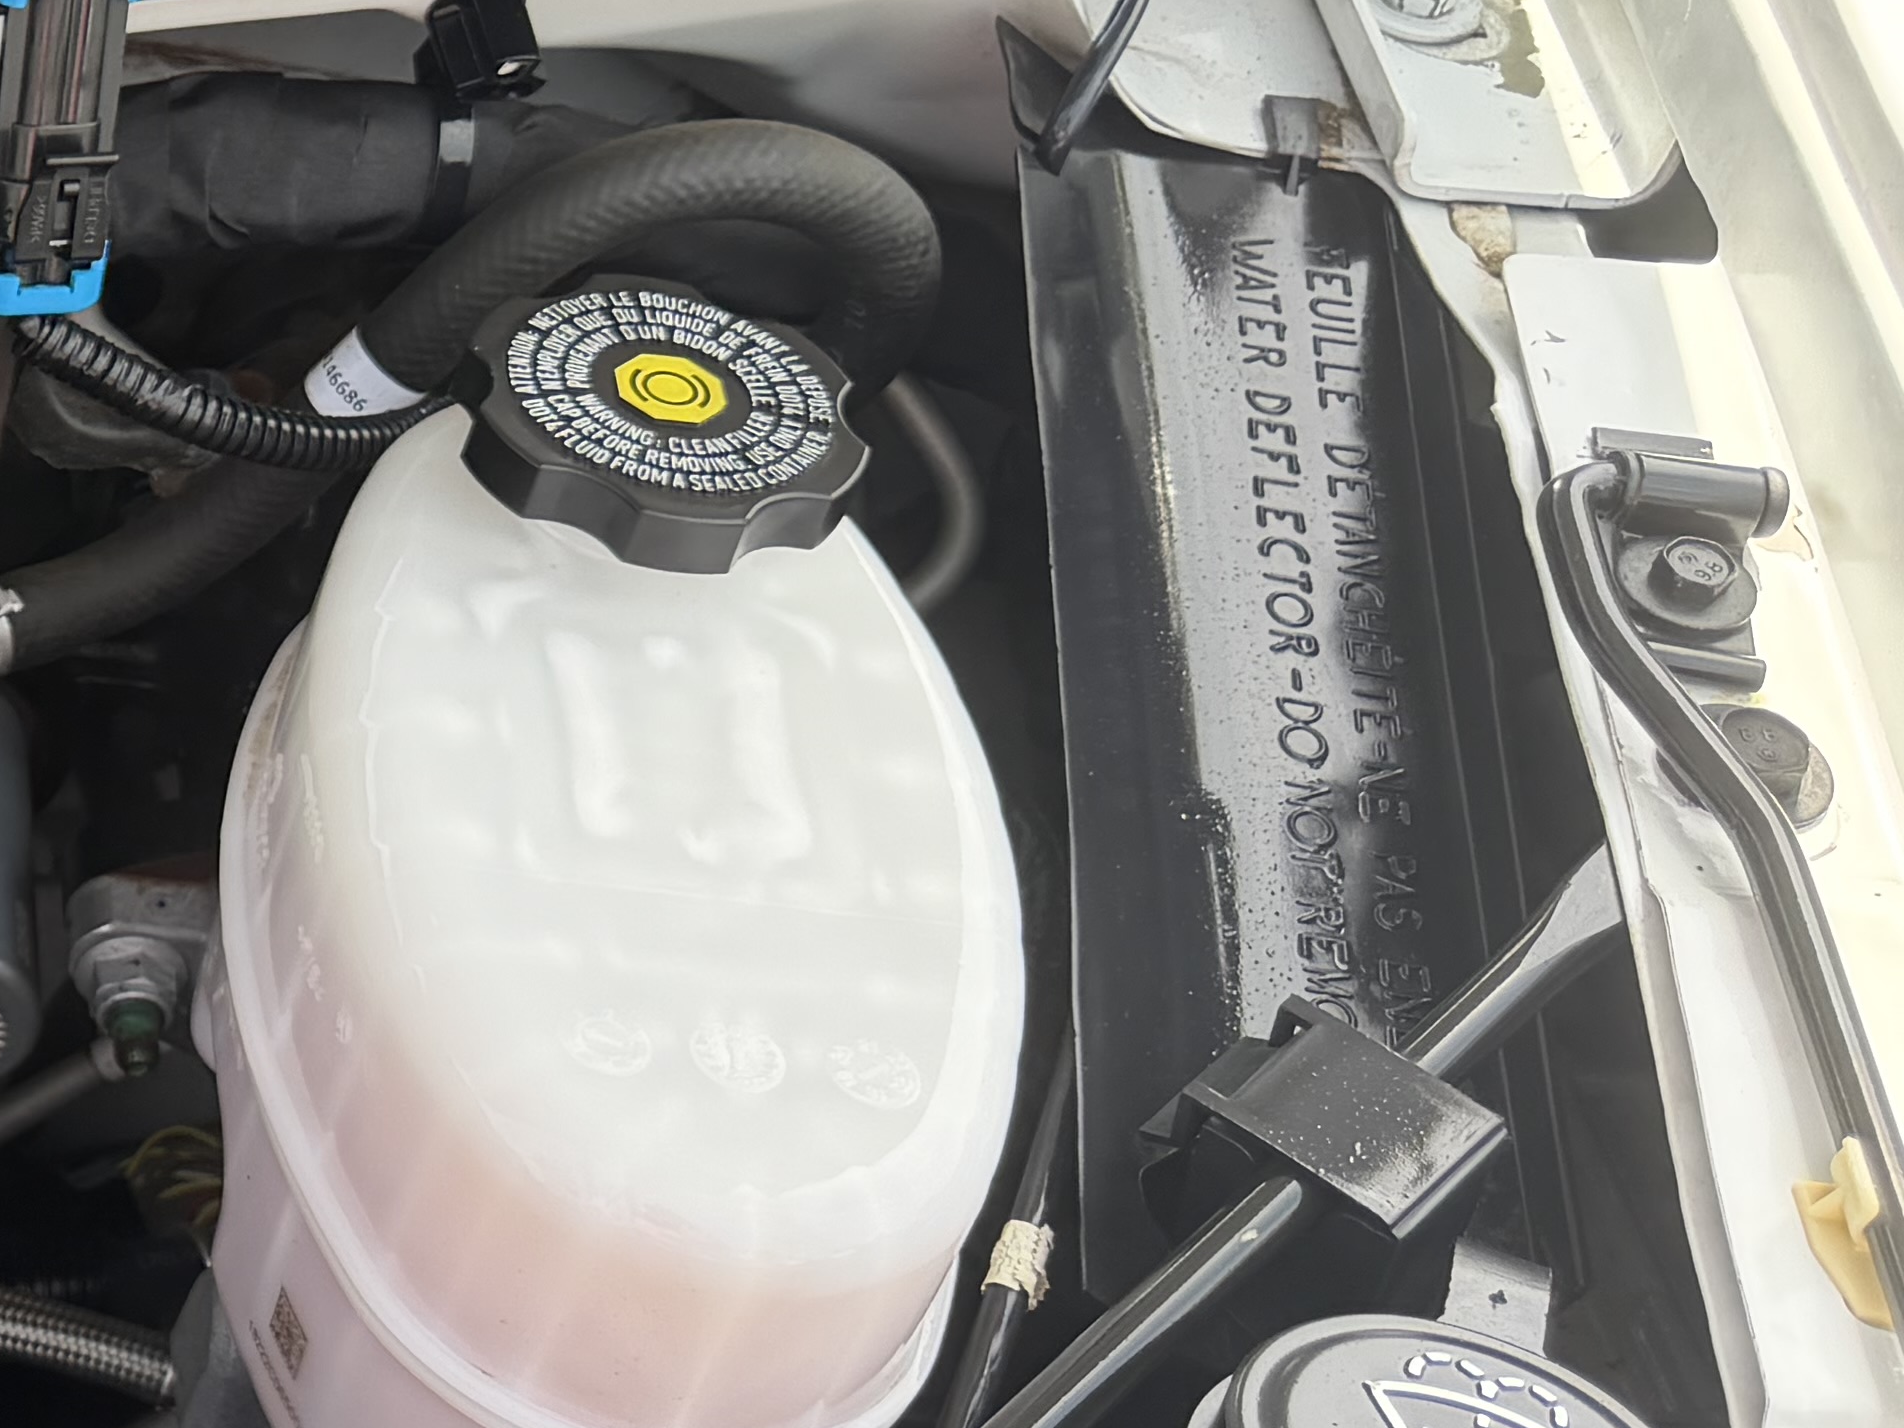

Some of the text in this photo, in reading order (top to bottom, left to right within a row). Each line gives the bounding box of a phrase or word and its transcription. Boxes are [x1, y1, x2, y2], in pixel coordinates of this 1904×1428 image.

[508, 329, 540, 394] ATTENTION:
[528, 292, 608, 330] NETTOYER
[609, 291, 634, 307] LE
[639, 291, 733, 326] BOUCHON
[730, 319, 792, 354] AVANT
[780, 355, 811, 374] LA
[564, 325, 778, 408] PROVENANT D'UN BIDON SCELLE
[573, 311, 612, 331] QUE
[611, 308, 641, 323] DU
[645, 309, 717, 336] LIQUIDE
[718, 330, 747, 350] DE
[743, 345, 791, 383] FREIN
[1304, 241, 1363, 412] FEUILLE
[547, 394, 805, 473] CAP BEFORE REMOVING. USE ONLY
[554, 428, 613, 464] FLUID
[610, 455, 670, 487] FROM
[672, 472, 686, 489] A
[688, 471, 765, 492] SEALED
[668, 436, 733, 455] CLEAN
[725, 411, 776, 445] FILLER
[1231, 238, 1287, 367] WATER
[1284, 779, 1345, 884] NOT
